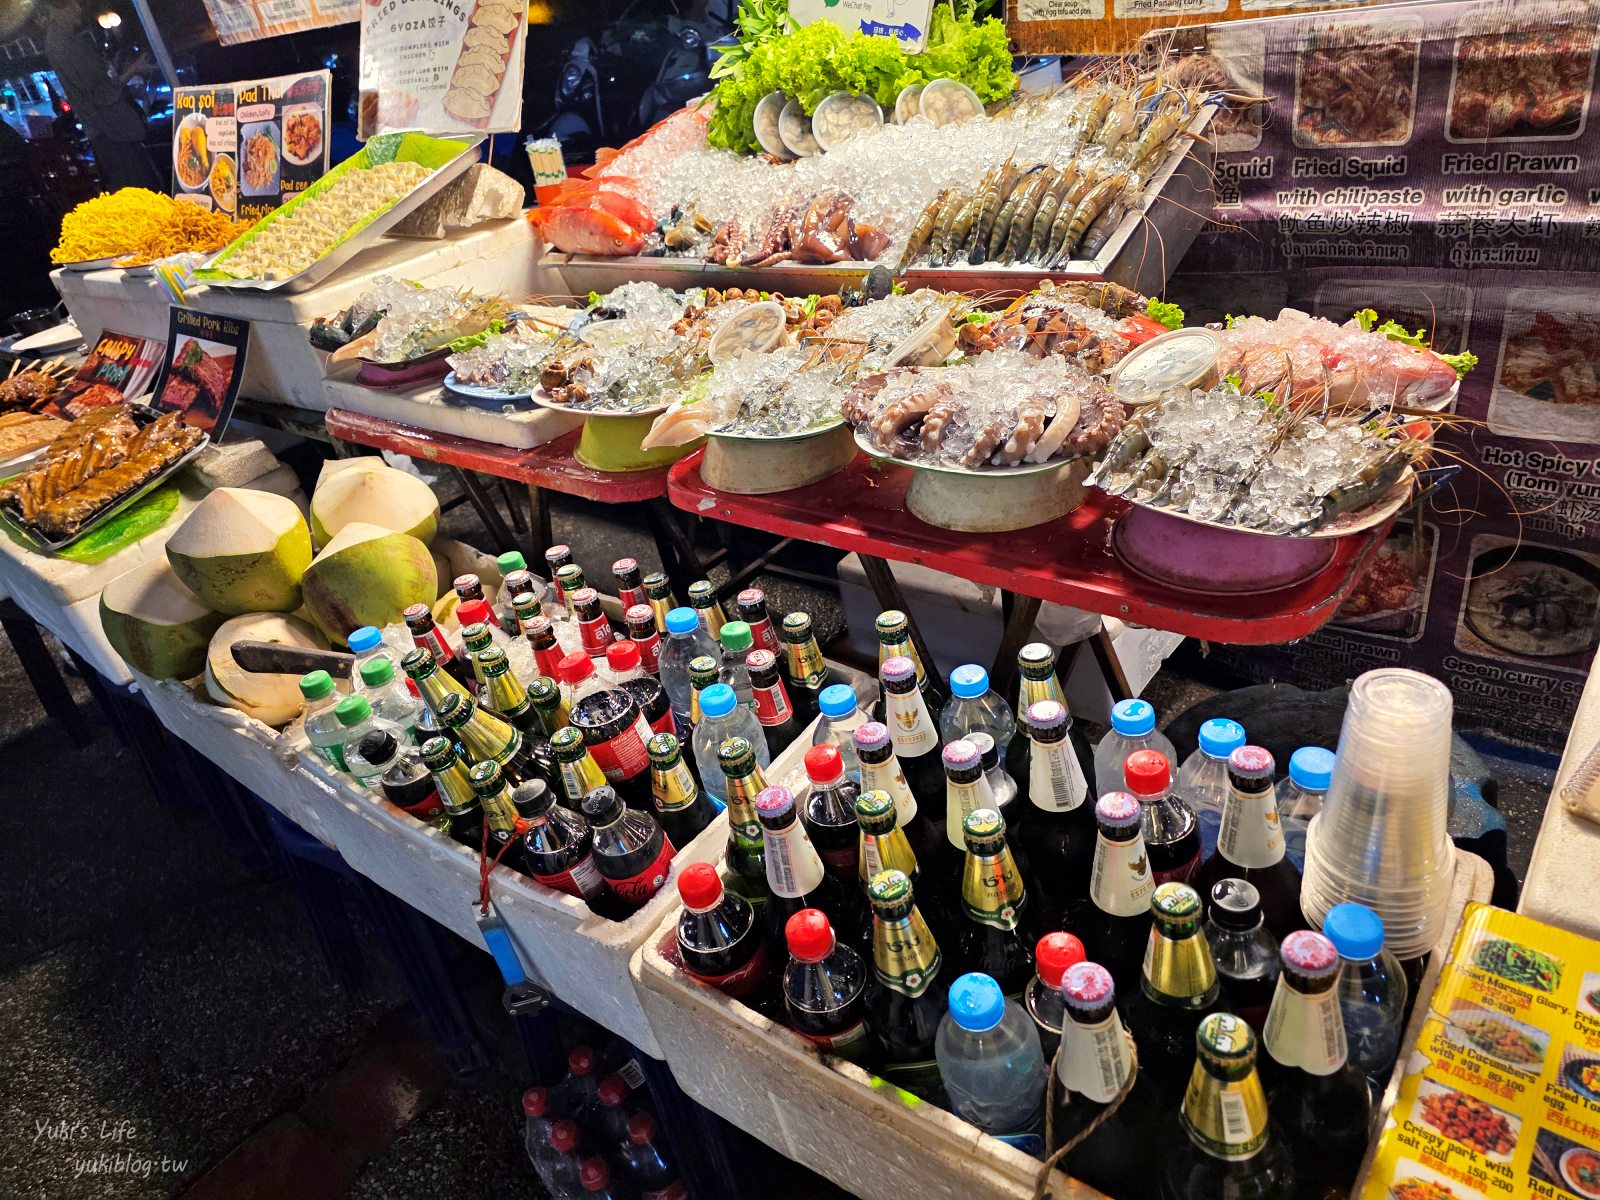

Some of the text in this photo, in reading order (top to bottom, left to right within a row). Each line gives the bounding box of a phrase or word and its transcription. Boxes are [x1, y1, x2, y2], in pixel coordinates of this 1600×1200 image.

[177, 92, 195, 109] Kao
[199, 90, 216, 109] soi
[239, 87, 257, 104] Pad
[1294, 157, 1406, 179] Fried Squid
[1443, 153, 1579, 172] Fried Prawn
[280, 179, 294, 191] Pad
[1445, 185, 1566, 206] with garlic
[1278, 187, 1423, 208] with chilipaste
[241, 203, 261, 215] Fried
[203, 315, 221, 332] Pork
[97, 338, 137, 361] CRISPY
[96, 363, 130, 382] PORK
[1483, 448, 1522, 466] Hot
[1526, 453, 1590, 478] Spicy
[1506, 470, 1558, 492] (Tom
[1345, 643, 1400, 660] prawn
[1444, 656, 1500, 678] Green
[1505, 671, 1559, 692] curry
[1452, 676, 1491, 695] tofu
[1487, 976, 1534, 1001] Morning
[1432, 1034, 1464, 1055] Fried
[1430, 1044, 1526, 1094] with egg 80-100
[1545, 1082, 1578, 1105] Fried
[1397, 1132, 1420, 1150] salt
[1403, 1119, 1514, 1180] Crispy pork with
[1466, 1165, 1514, 1194] 150-200
[1528, 1176, 1553, 1198] Red
